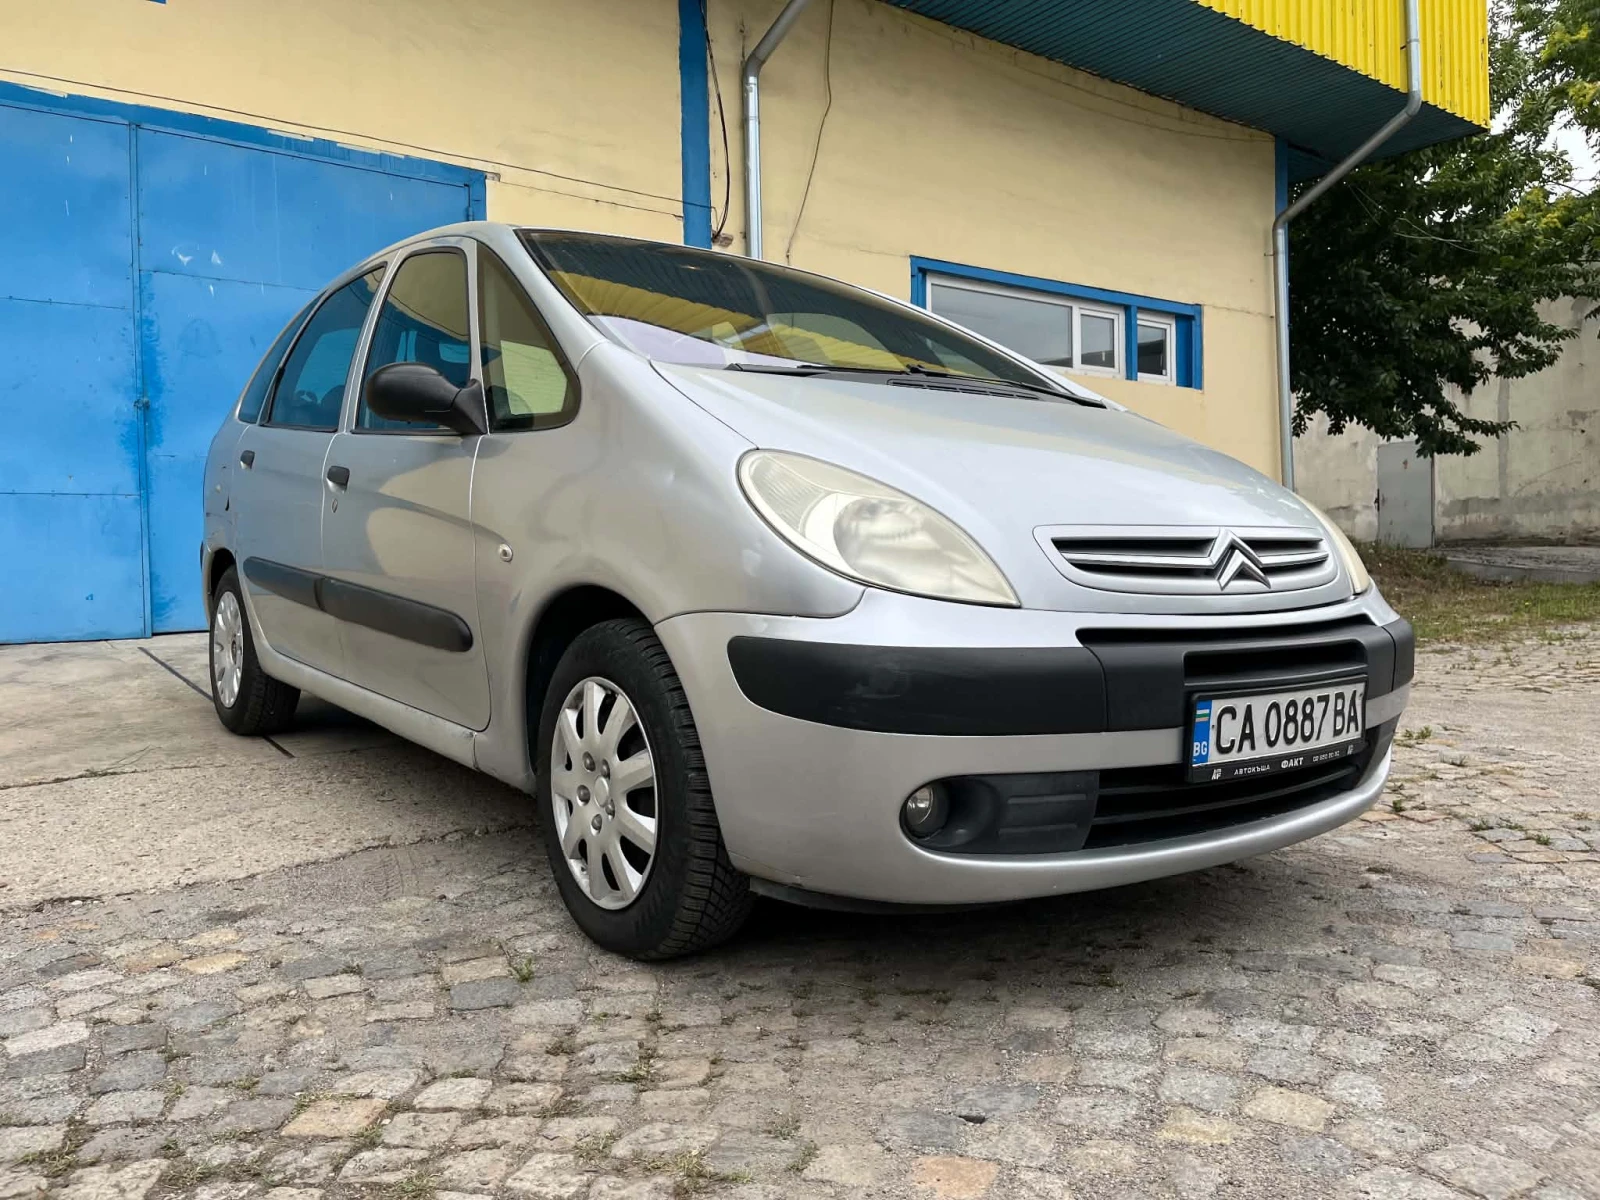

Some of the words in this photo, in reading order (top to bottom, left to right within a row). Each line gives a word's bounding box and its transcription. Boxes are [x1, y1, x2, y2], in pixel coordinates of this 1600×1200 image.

[1215, 703, 1256, 755] CA
[1265, 693, 1330, 748] 0887
[1332, 689, 1359, 738] BA
[1193, 741, 1208, 757] BG
[1281, 757, 1304, 769] ФАКТ
